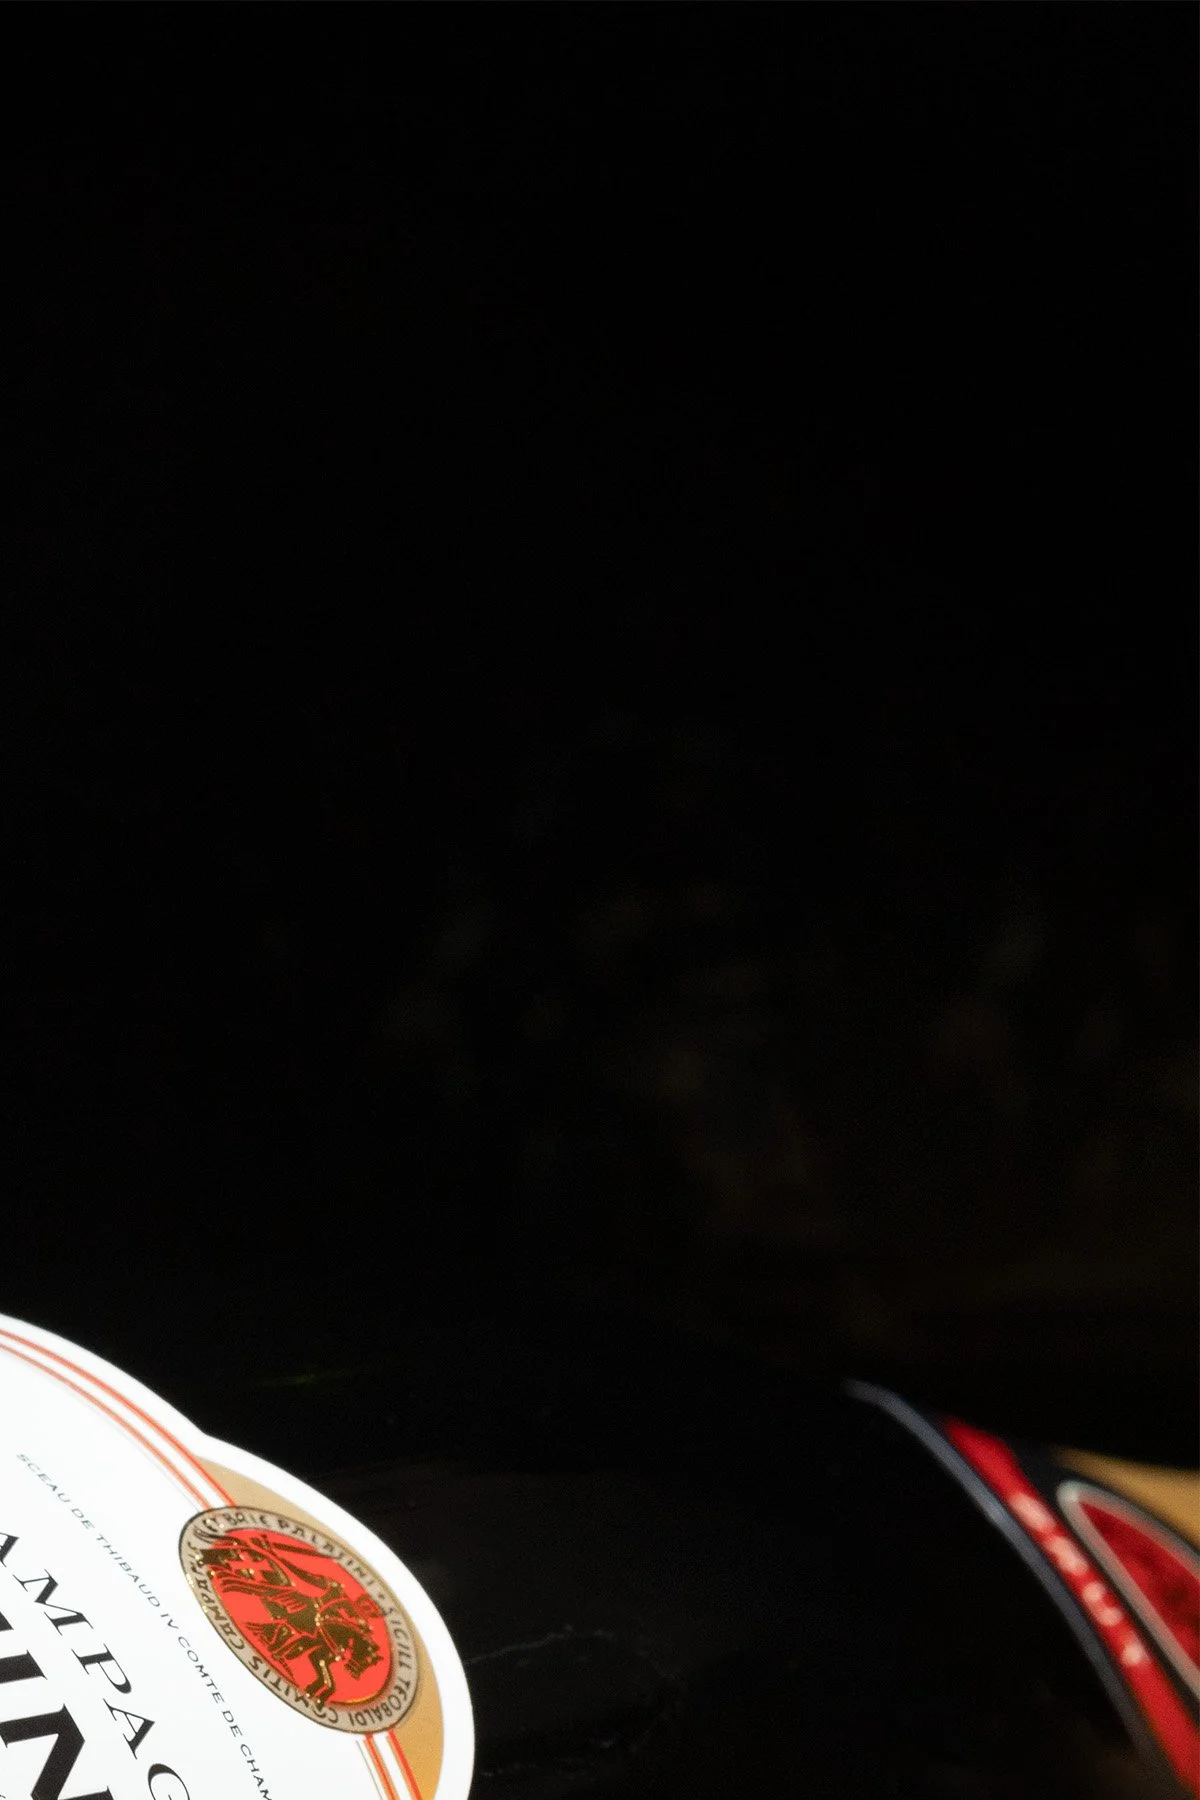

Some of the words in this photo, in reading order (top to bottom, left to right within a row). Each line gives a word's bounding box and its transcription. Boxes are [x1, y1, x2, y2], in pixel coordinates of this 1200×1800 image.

[16, 1453, 71, 1504] SCEAU
[71, 1507, 95, 1530] DE
[96, 1534, 161, 1608] THIBAUD
[160, 1613, 179, 1630] IV
[177, 1636, 225, 1704] COMTE
[221, 1709, 243, 1738] DE
